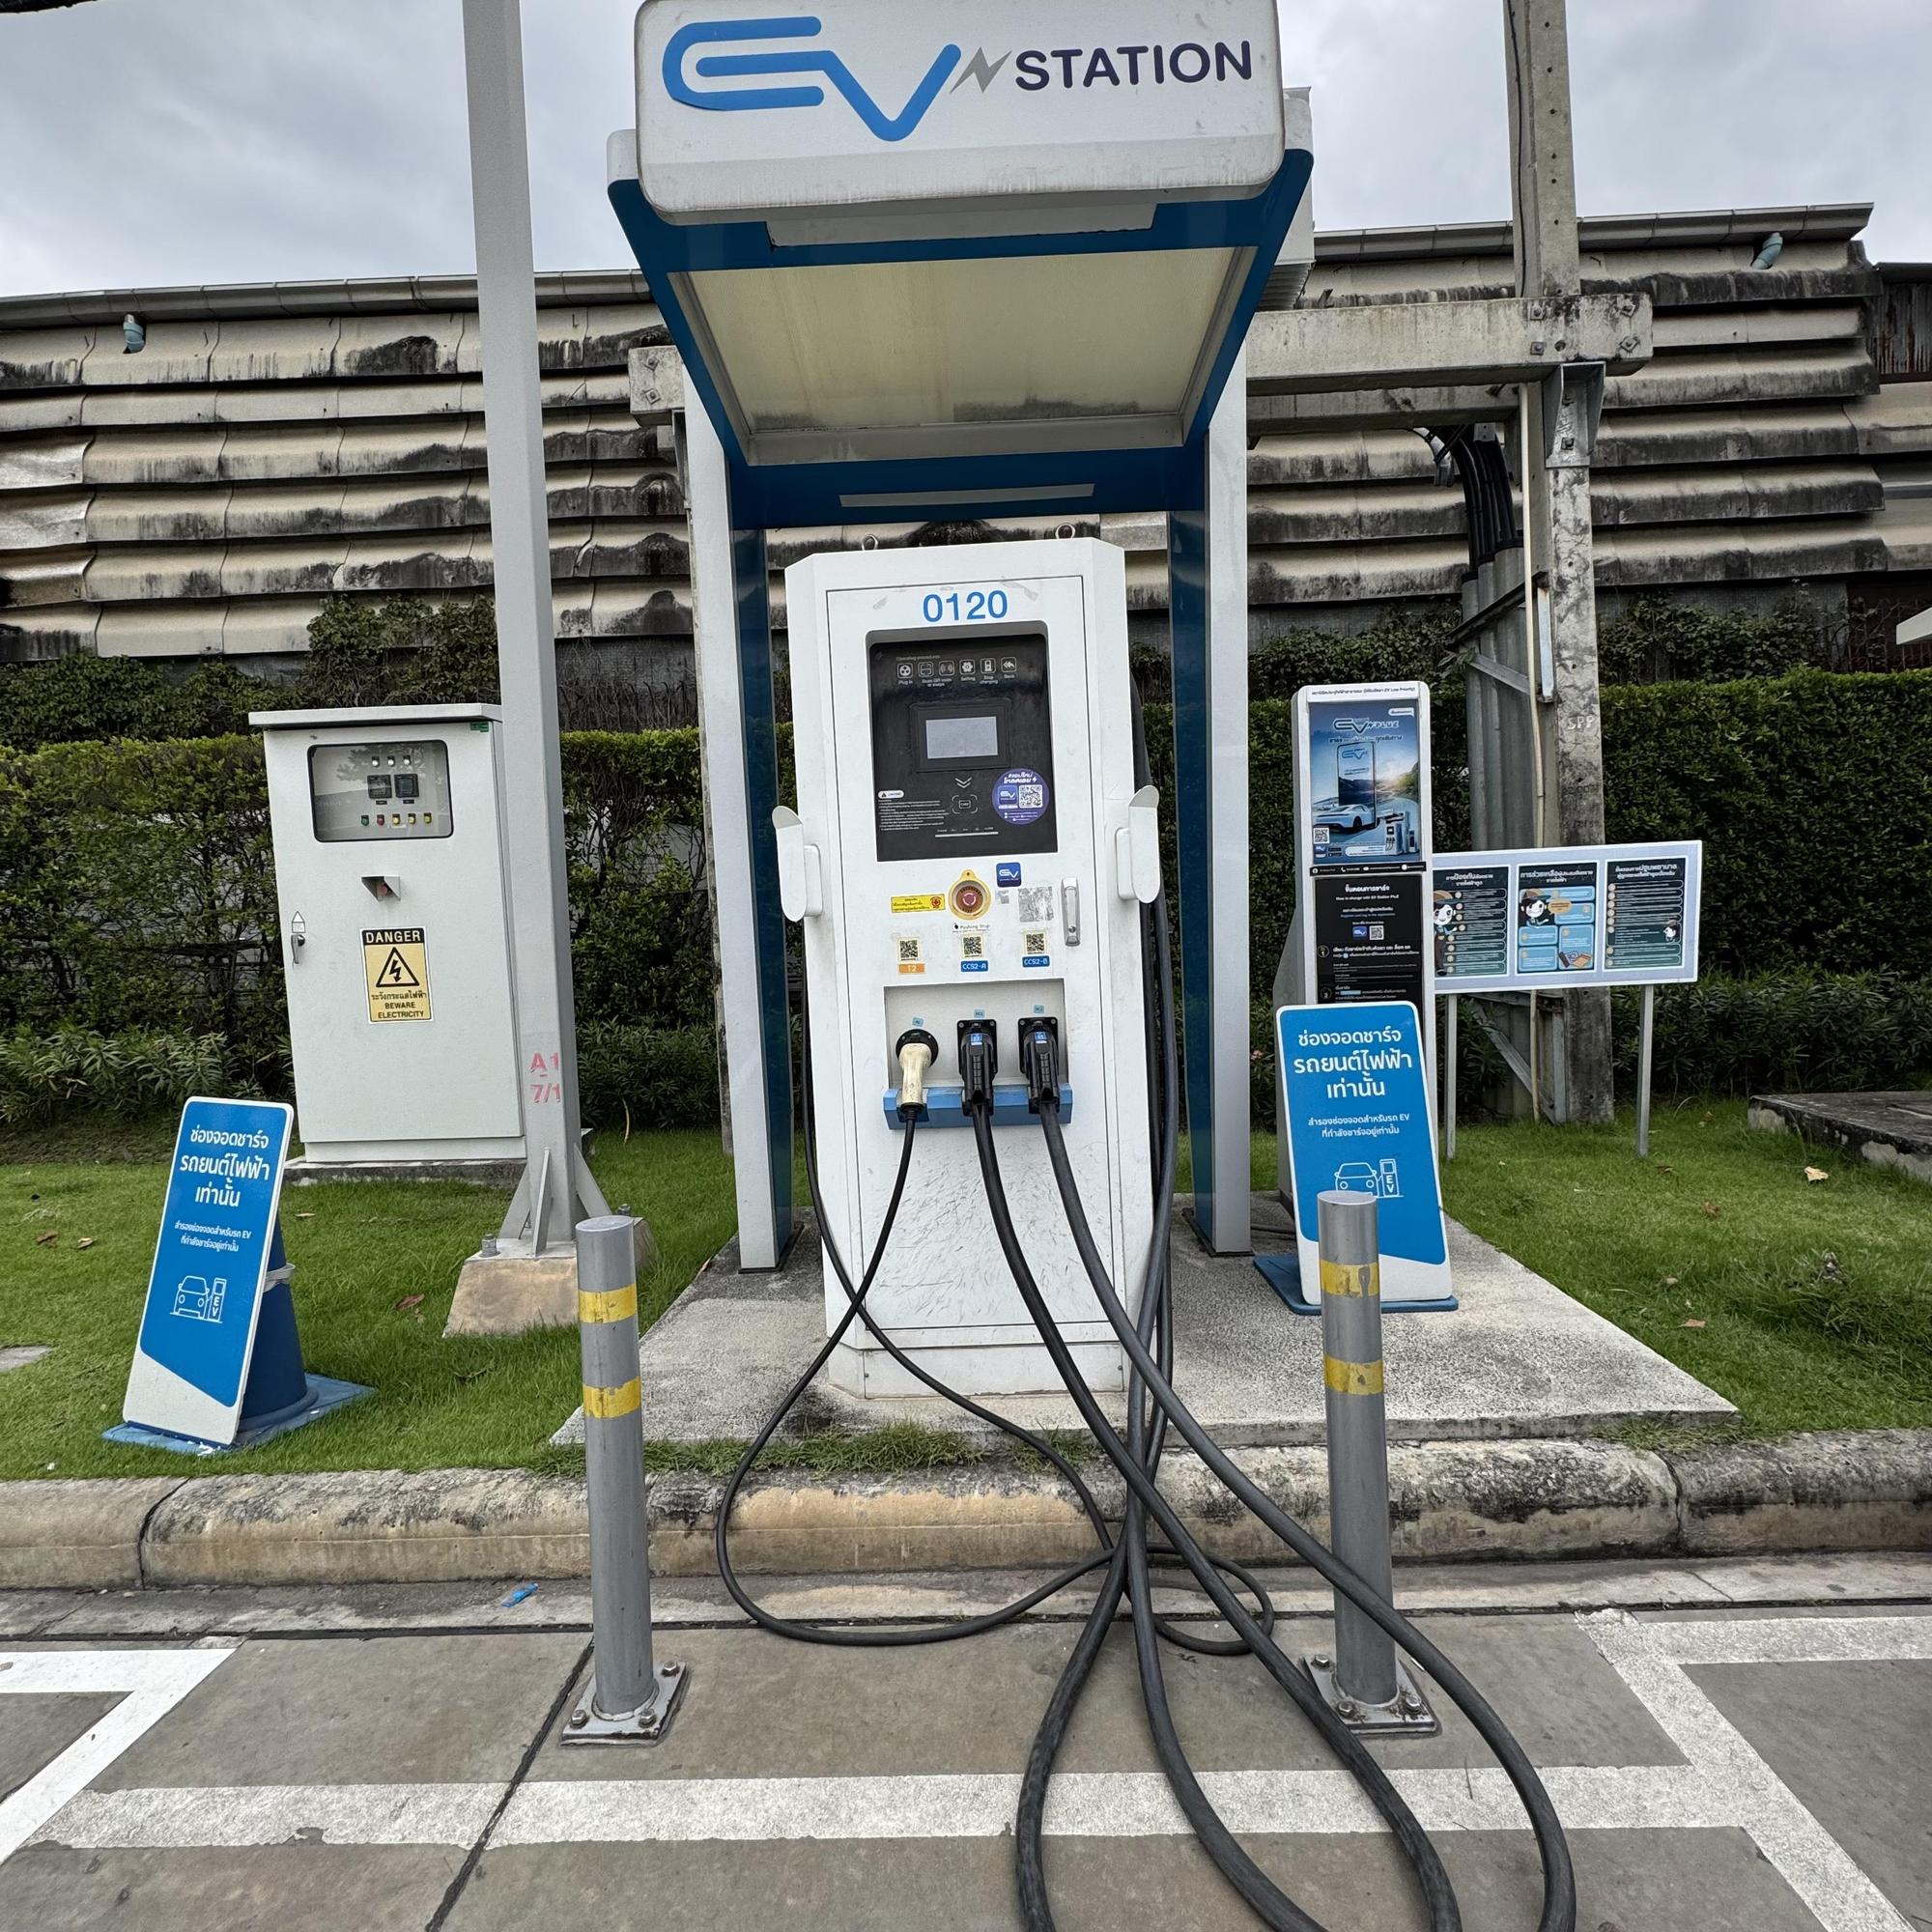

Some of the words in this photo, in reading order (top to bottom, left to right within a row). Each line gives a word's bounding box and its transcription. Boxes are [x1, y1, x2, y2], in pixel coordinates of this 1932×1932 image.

[662, 16, 961, 141] EV
[1015, 41, 1253, 92] STATION
[923, 590, 1009, 622] 0120
[365, 930, 421, 944] DANGER
[378, 1010, 424, 1019] ELECTRICITY
[1298, 1025, 1402, 1047] ช่องจอดชาร์จ
[1293, 1048, 1412, 1074] รถยนต์ไฟฟ้า
[1326, 1071, 1386, 1098] เท่านั้น
[1308, 1114, 1399, 1126] สำรองช่องจอดสำหรับรถ
[190, 1124, 270, 1150] ช่องจอดชาร์จ
[180, 1153, 270, 1180] รถยนต์ไฟฟ้า
[195, 1179, 241, 1208] เท่านั้น
[242, 1230, 252, 1239] EV
